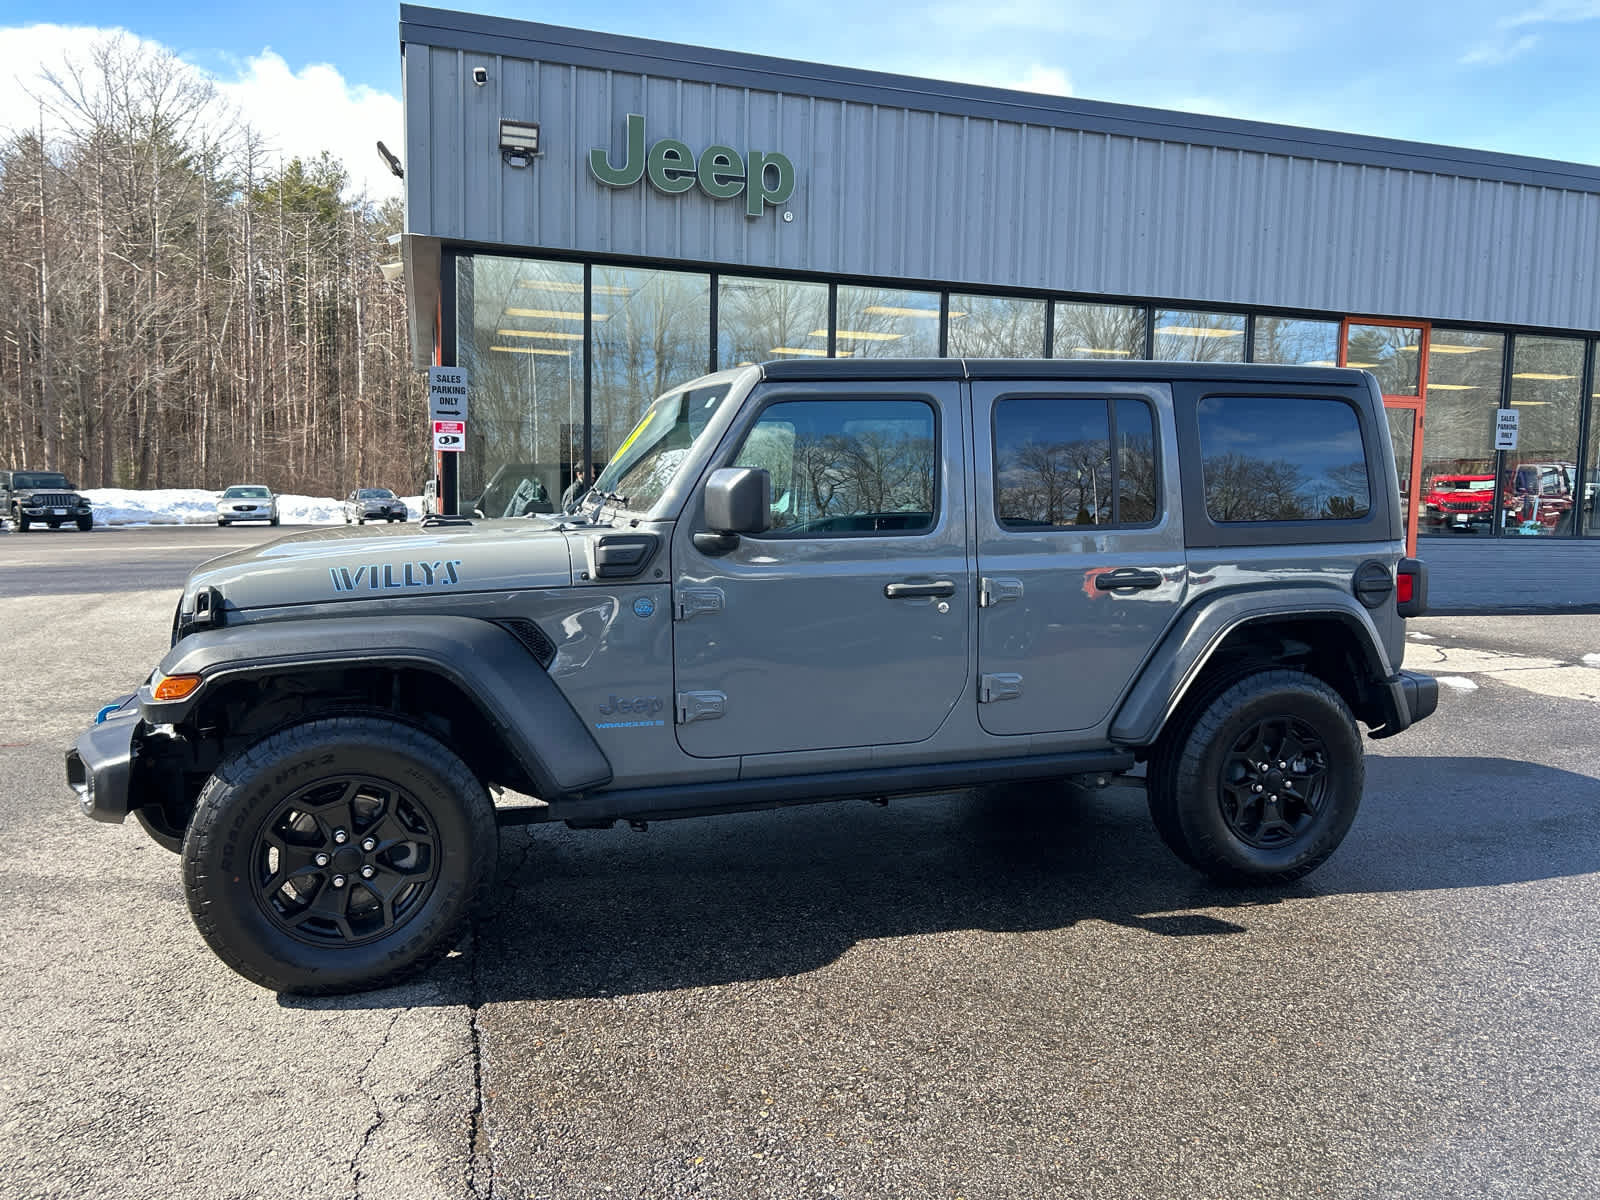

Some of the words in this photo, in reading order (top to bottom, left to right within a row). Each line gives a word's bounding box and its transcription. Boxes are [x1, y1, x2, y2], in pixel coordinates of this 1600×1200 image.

[589, 112, 795, 217] Jeep
[436, 374, 461, 384] SALES
[431, 385, 466, 395] PARKING
[439, 396, 459, 406] ONLY
[329, 560, 462, 592] WILLYS
[599, 694, 664, 719] Jeep
